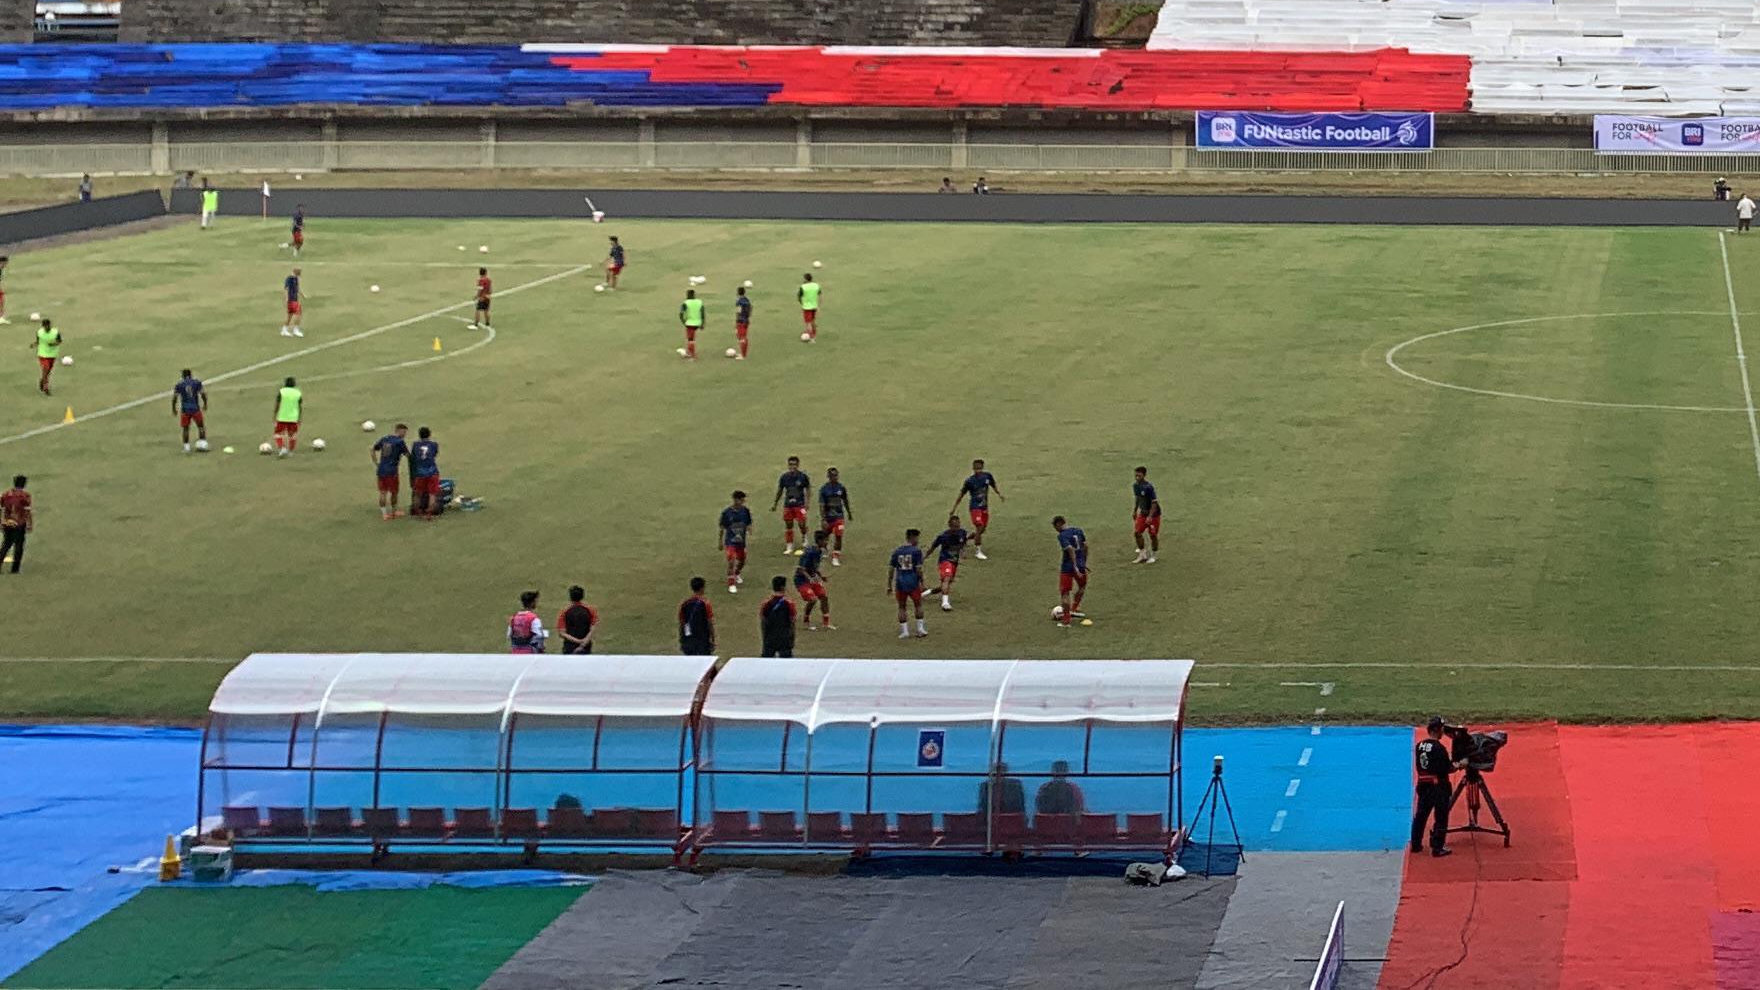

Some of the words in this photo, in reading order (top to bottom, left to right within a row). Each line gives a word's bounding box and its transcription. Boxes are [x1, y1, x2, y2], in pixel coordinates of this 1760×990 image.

[1612, 122, 1663, 132] FOOTBALL
[1684, 127, 1702, 136] BRI
[1243, 124, 1322, 140] FUNtastic
[1325, 125, 1390, 141] Football
[1612, 131, 1632, 140] FOR
[419, 446, 429, 460] 7
